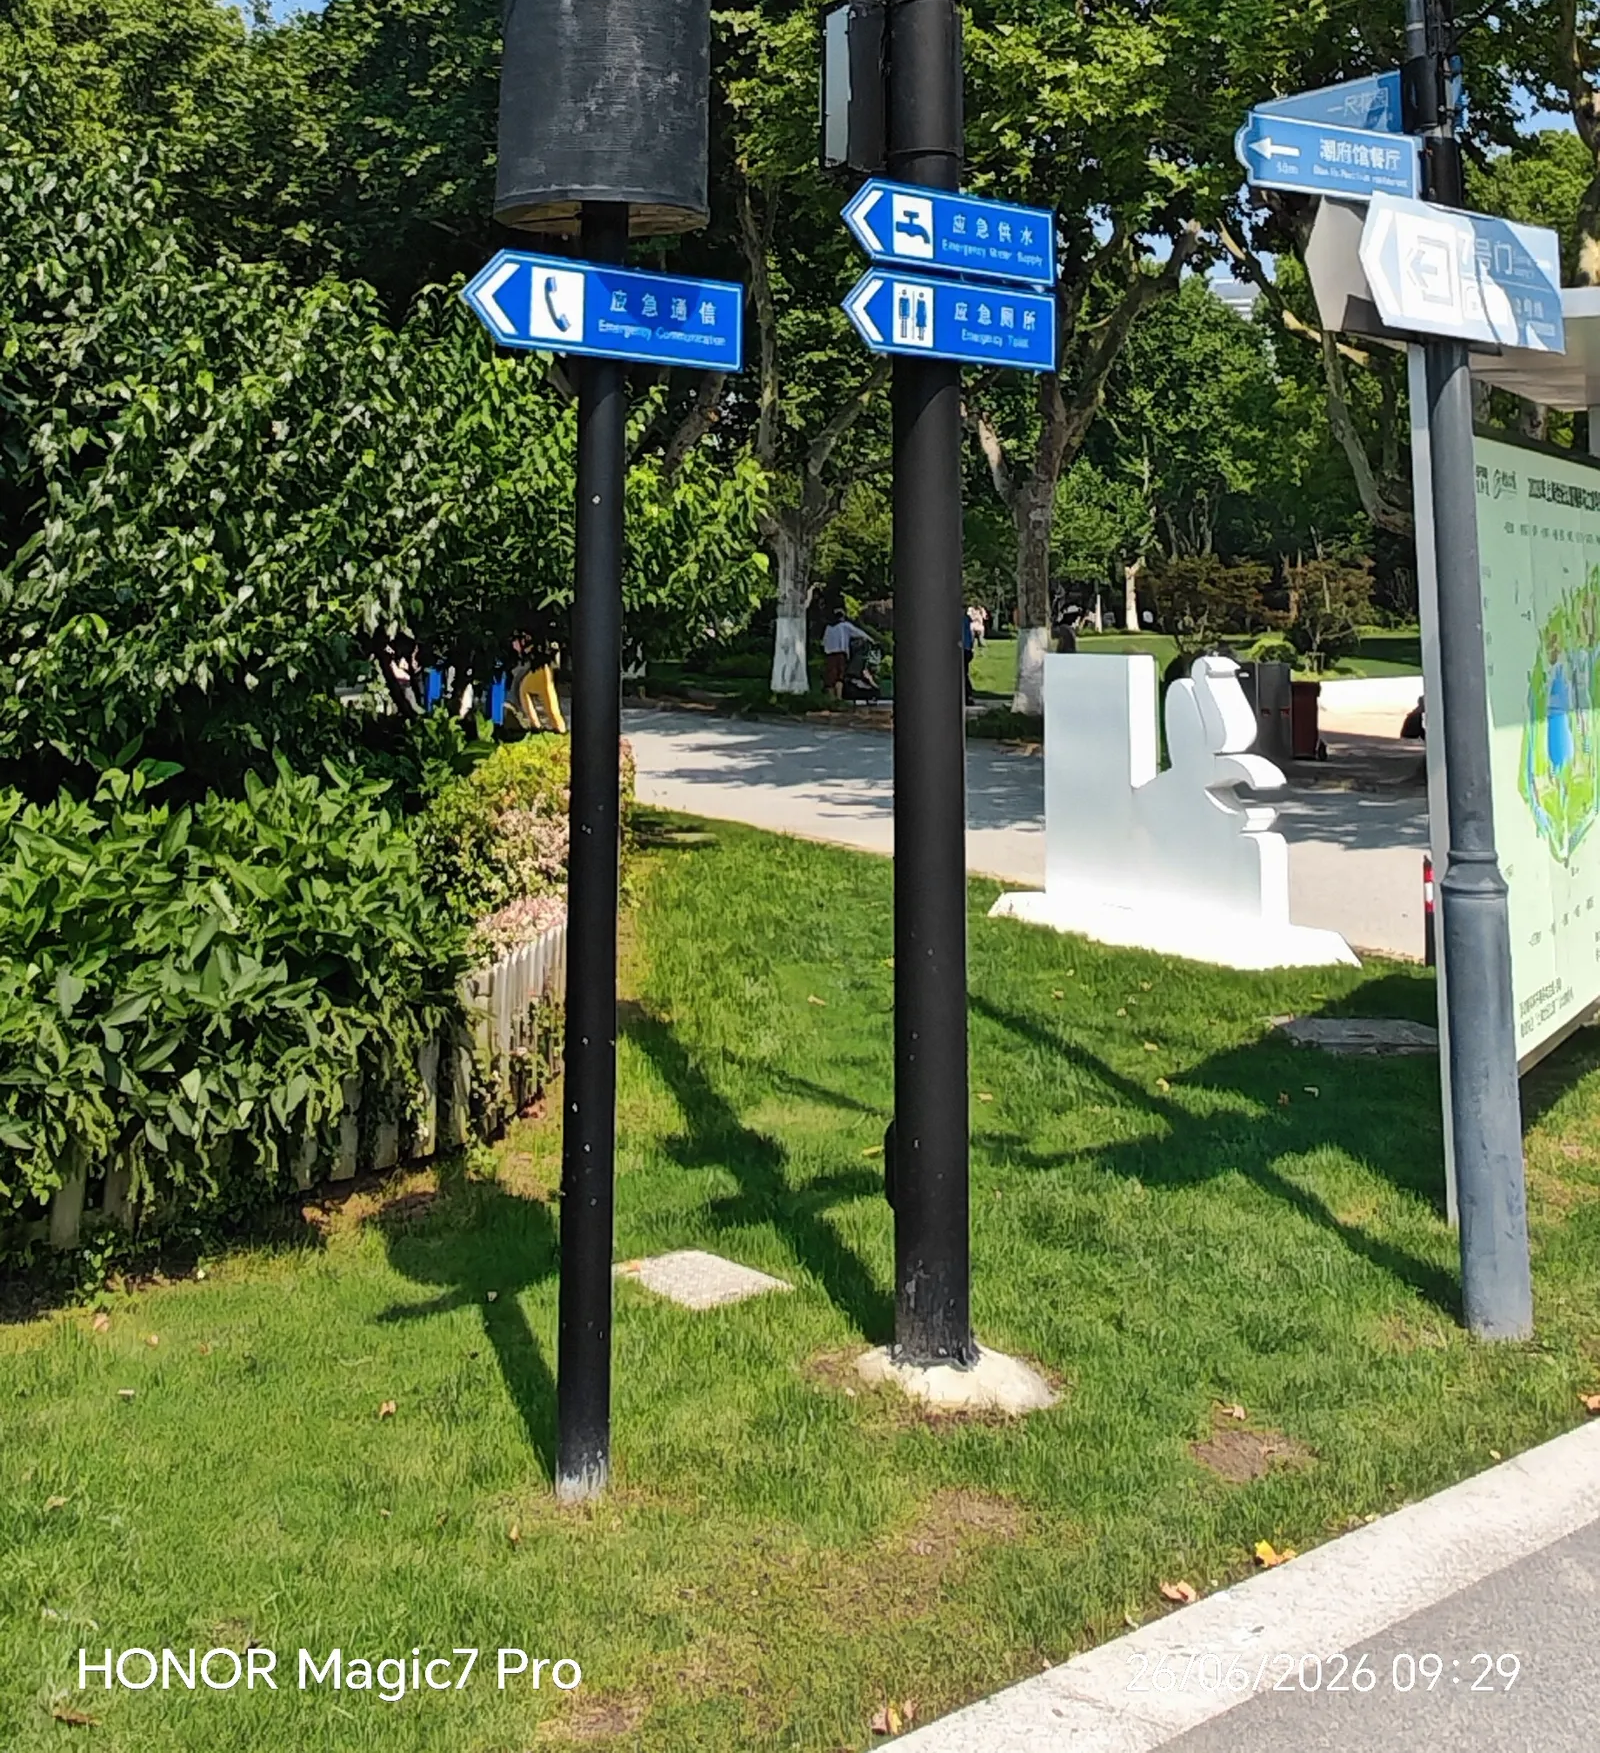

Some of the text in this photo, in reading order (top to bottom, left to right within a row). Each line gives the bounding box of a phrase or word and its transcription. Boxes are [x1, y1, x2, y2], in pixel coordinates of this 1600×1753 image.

[952, 214, 1033, 246] 应急供水
[942, 238, 986, 258] Emergency
[1017, 251, 1043, 267] Supply
[609, 289, 717, 325] 应急通信
[954, 302, 1036, 332] 应急厕所
[598, 319, 652, 341] Emergency
[961, 328, 1003, 348] Emergency
